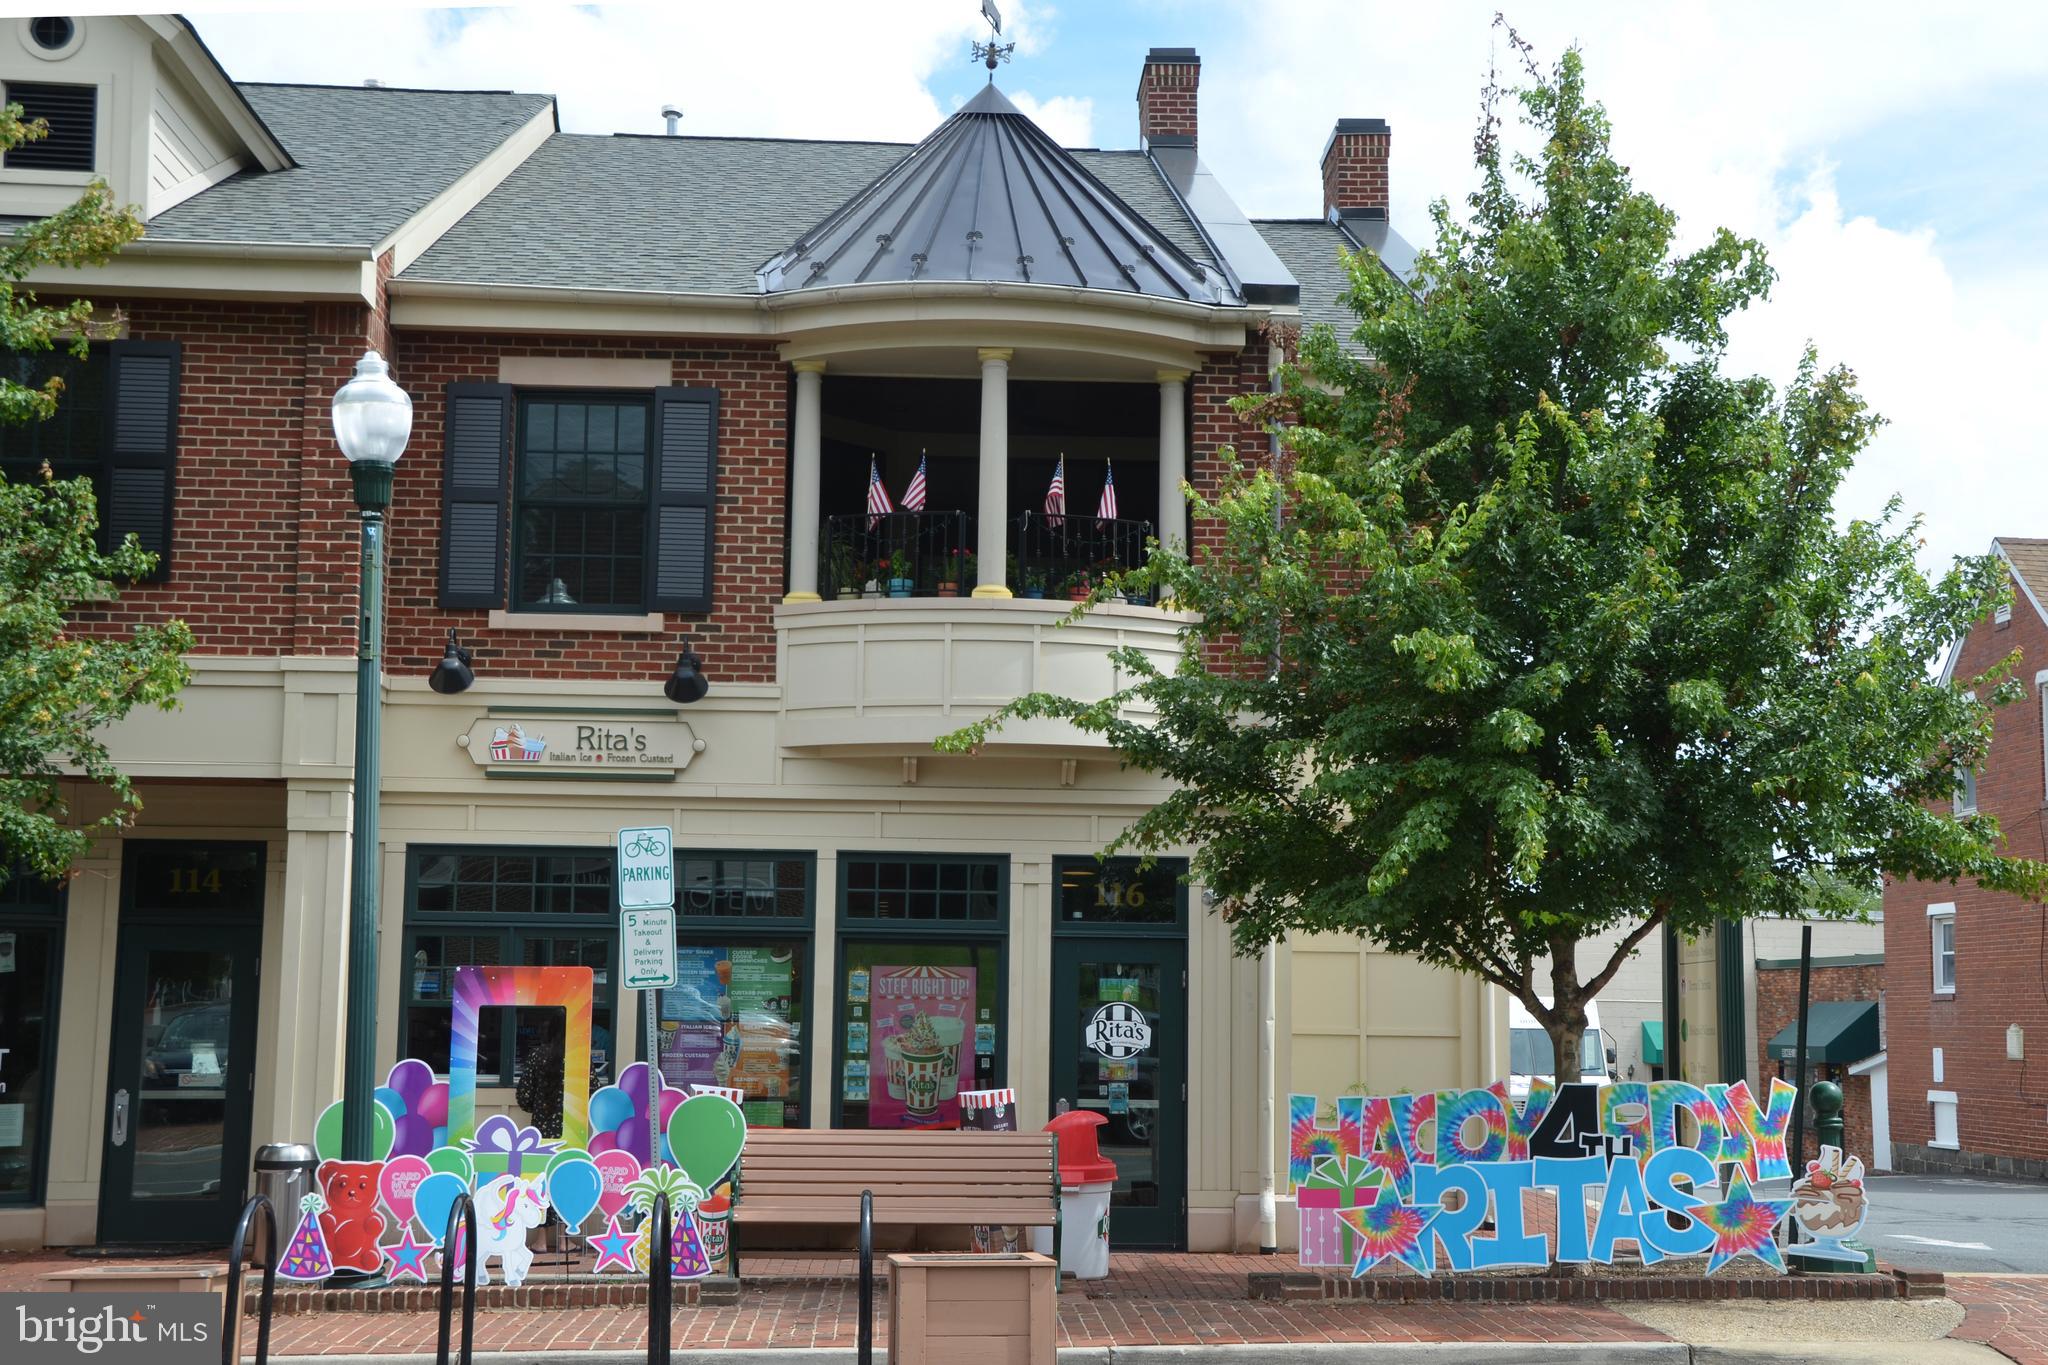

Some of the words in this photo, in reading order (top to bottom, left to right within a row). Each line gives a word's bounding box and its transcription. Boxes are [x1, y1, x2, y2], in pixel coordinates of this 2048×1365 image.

[576, 725, 647, 751] Rita's
[549, 752, 577, 762] Italian
[579, 753, 592, 762] Ice
[607, 753, 636, 763] Frozen
[640, 753, 674, 764] Custard
[169, 868, 223, 893] 114
[623, 865, 670, 882] PARKING
[1094, 882, 1145, 907] 116
[628, 914, 637, 927] 5
[643, 918, 667, 926] Minute
[633, 948, 663, 958] Delivery
[635, 958, 663, 967] Parking
[641, 967, 657, 976] Only
[880, 978, 908, 994] STEP
[912, 977, 946, 995] RIGHT
[951, 978, 970, 995] UP!
[1095, 1020, 1145, 1042] Rita's
[391, 1171, 421, 1181] CARD
[1411, 1146, 1718, 1272] RITAS
